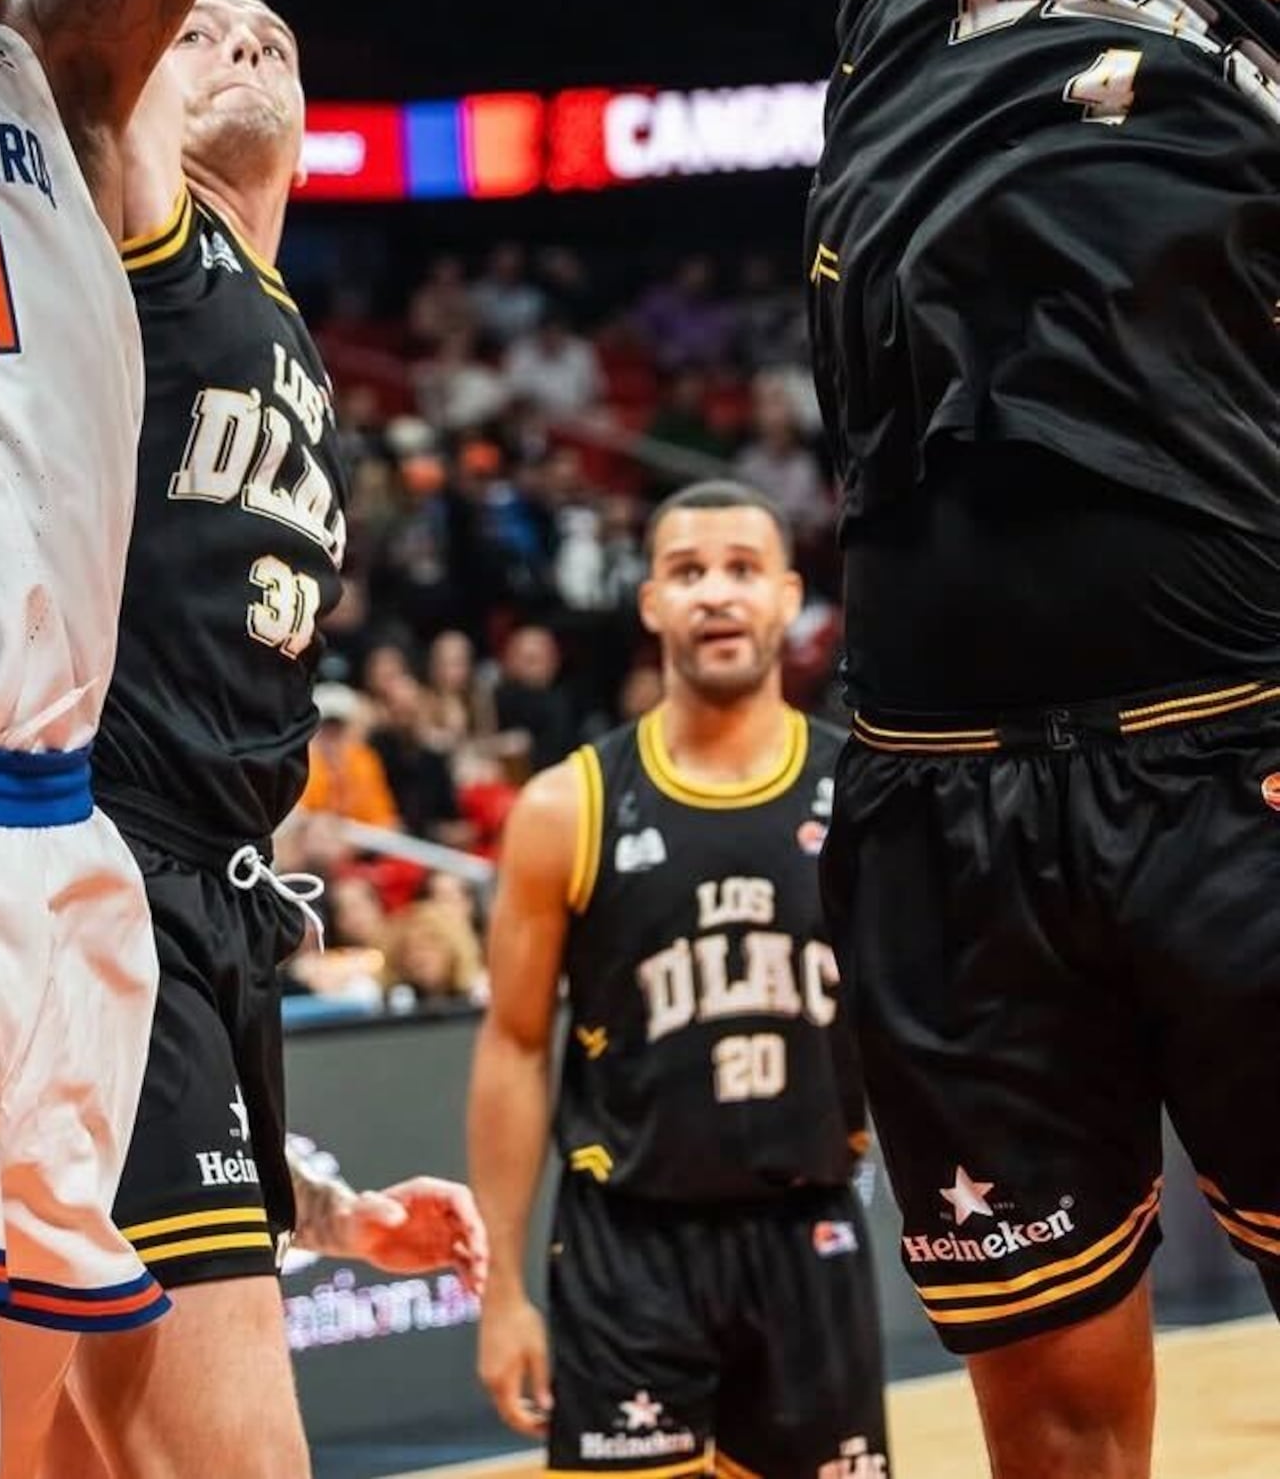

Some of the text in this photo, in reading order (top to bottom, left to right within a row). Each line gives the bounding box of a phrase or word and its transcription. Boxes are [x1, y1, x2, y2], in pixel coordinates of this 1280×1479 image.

[1062, 48, 1143, 125] 4
[273, 342, 324, 446] LOS
[696, 877, 776, 929] LOS
[712, 1032, 787, 1104] 20
[902, 1208, 1075, 1263] Heineken
